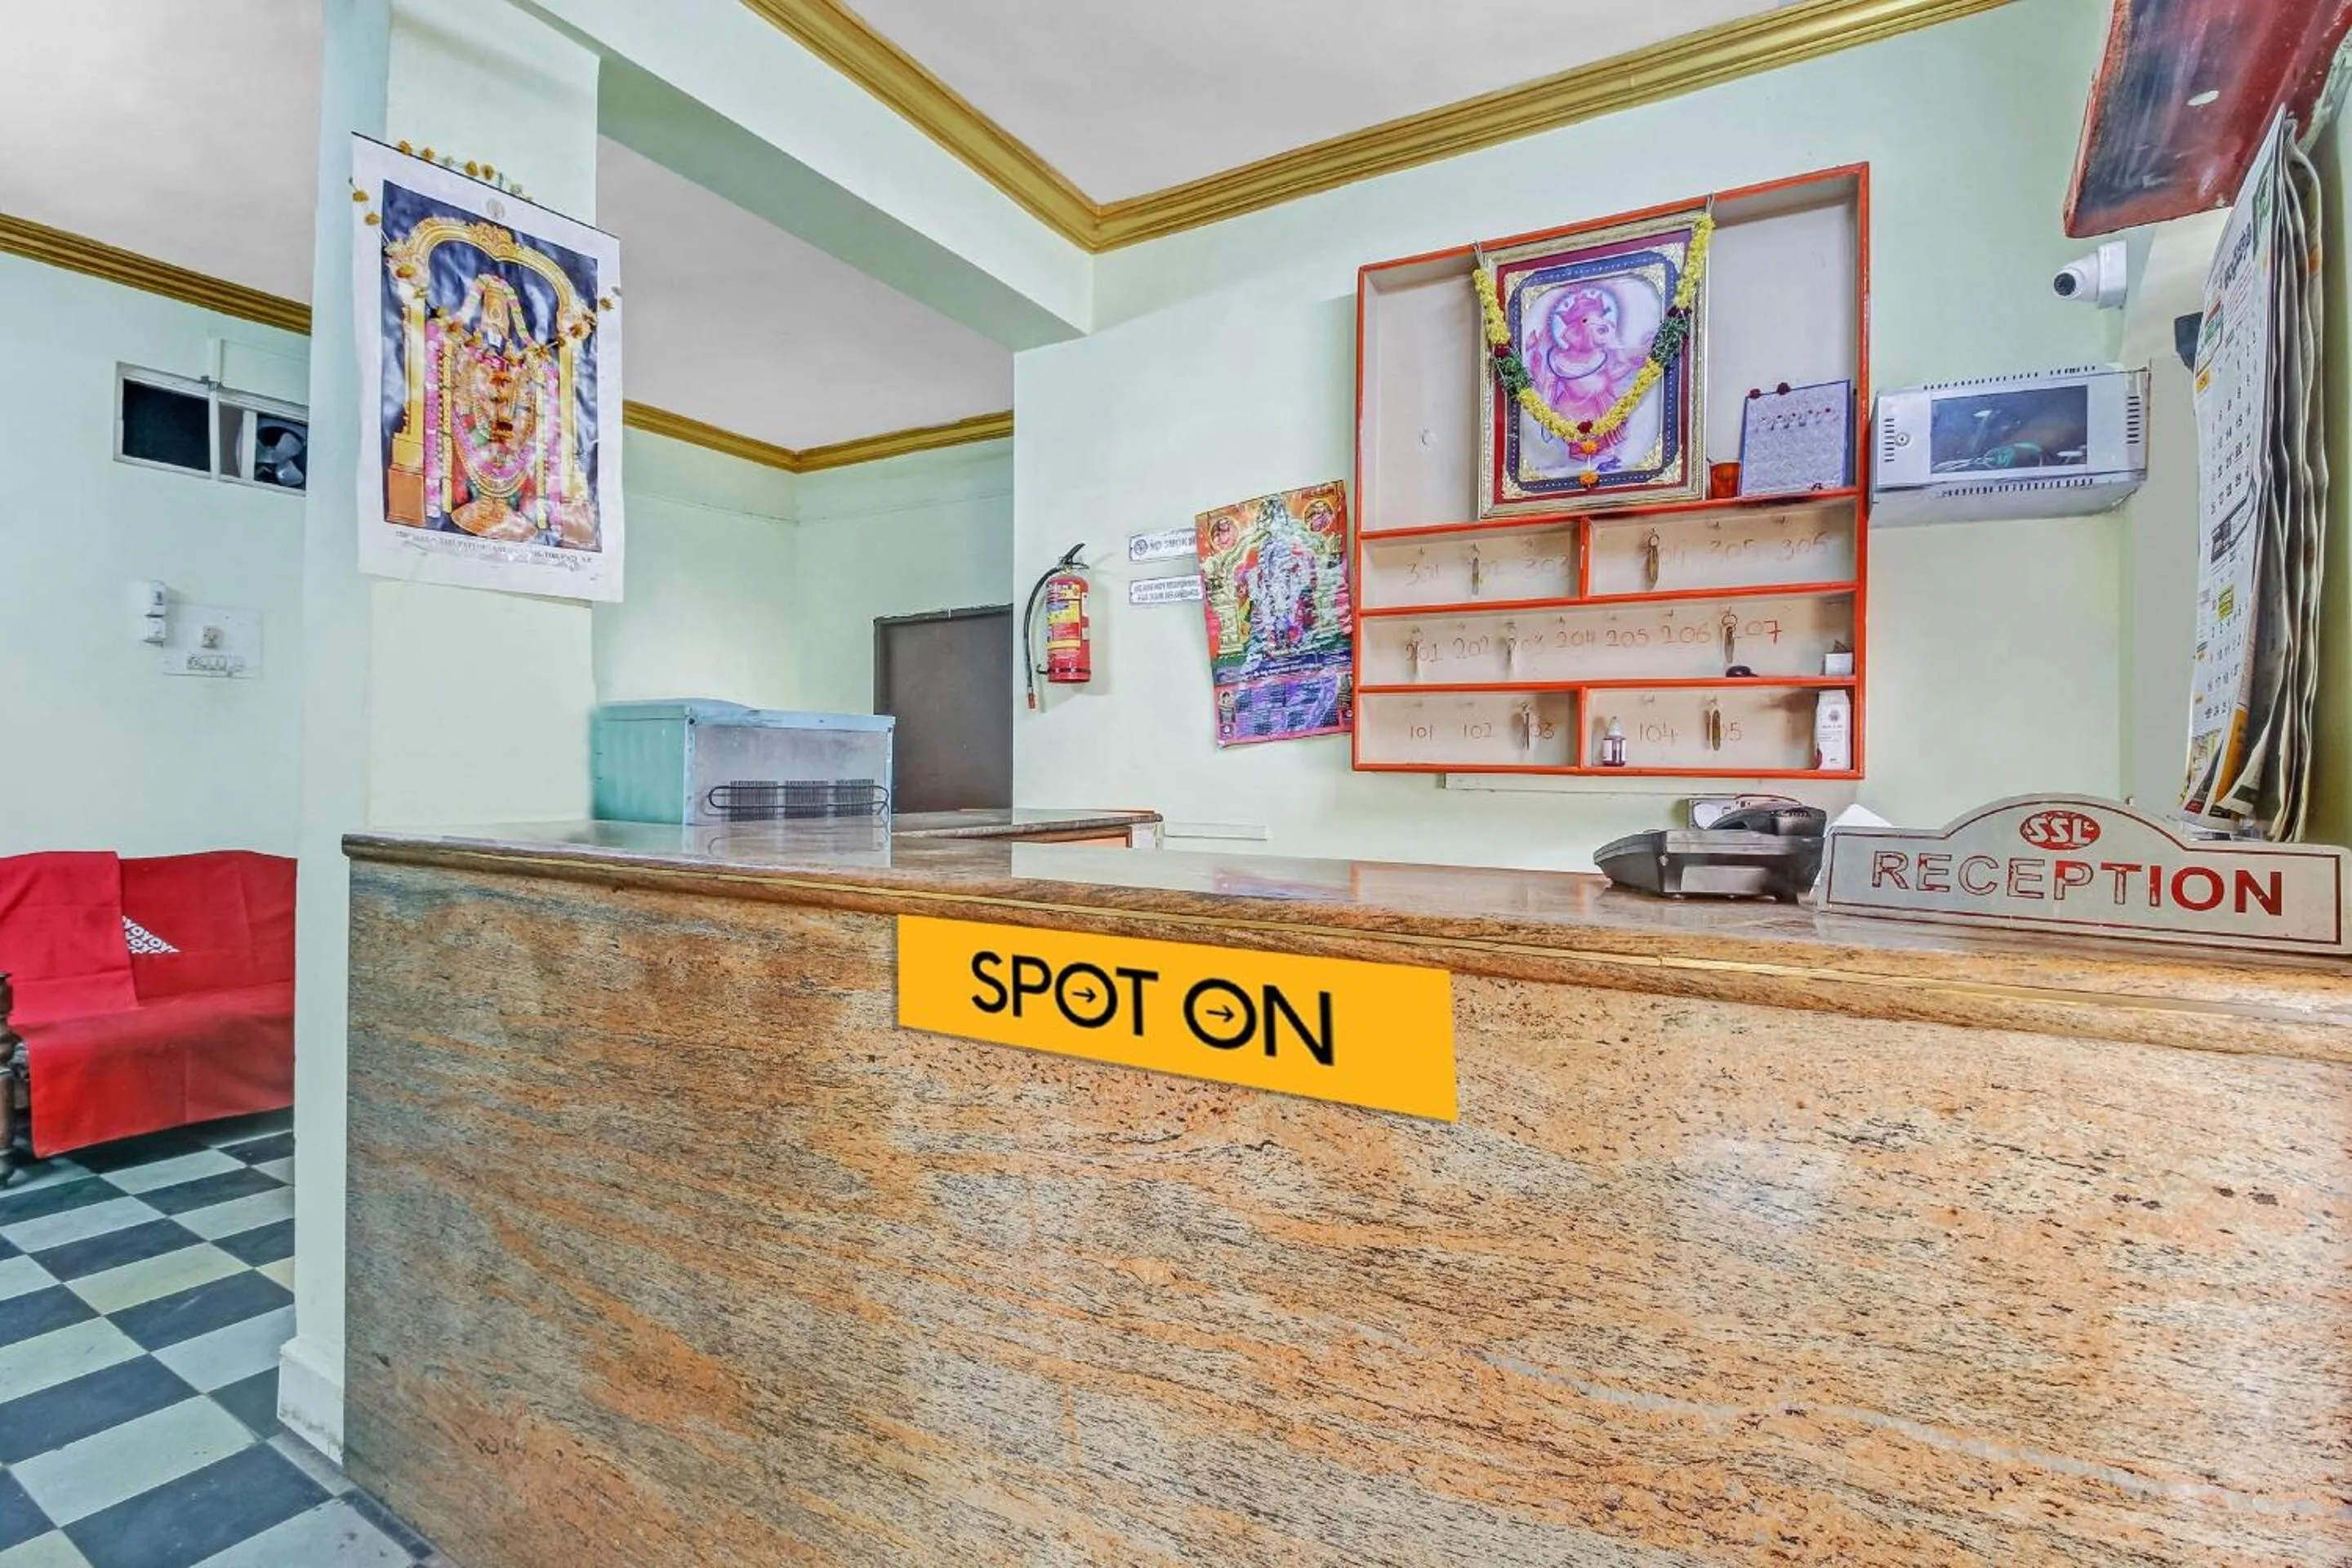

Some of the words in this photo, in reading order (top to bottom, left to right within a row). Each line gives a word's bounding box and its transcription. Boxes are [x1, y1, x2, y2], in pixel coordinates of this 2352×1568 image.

[1555, 628, 1596, 649] 204
[1606, 628, 1651, 648] 205
[1410, 724, 1434, 741] 101
[1463, 721, 1494, 741] 102
[1638, 721, 1679, 744] 104
[2027, 816, 2092, 844] SSL
[1870, 849, 2283, 917] RECEPTION
[970, 950, 1160, 1037] SPOT
[1183, 978, 1336, 1067] ON
